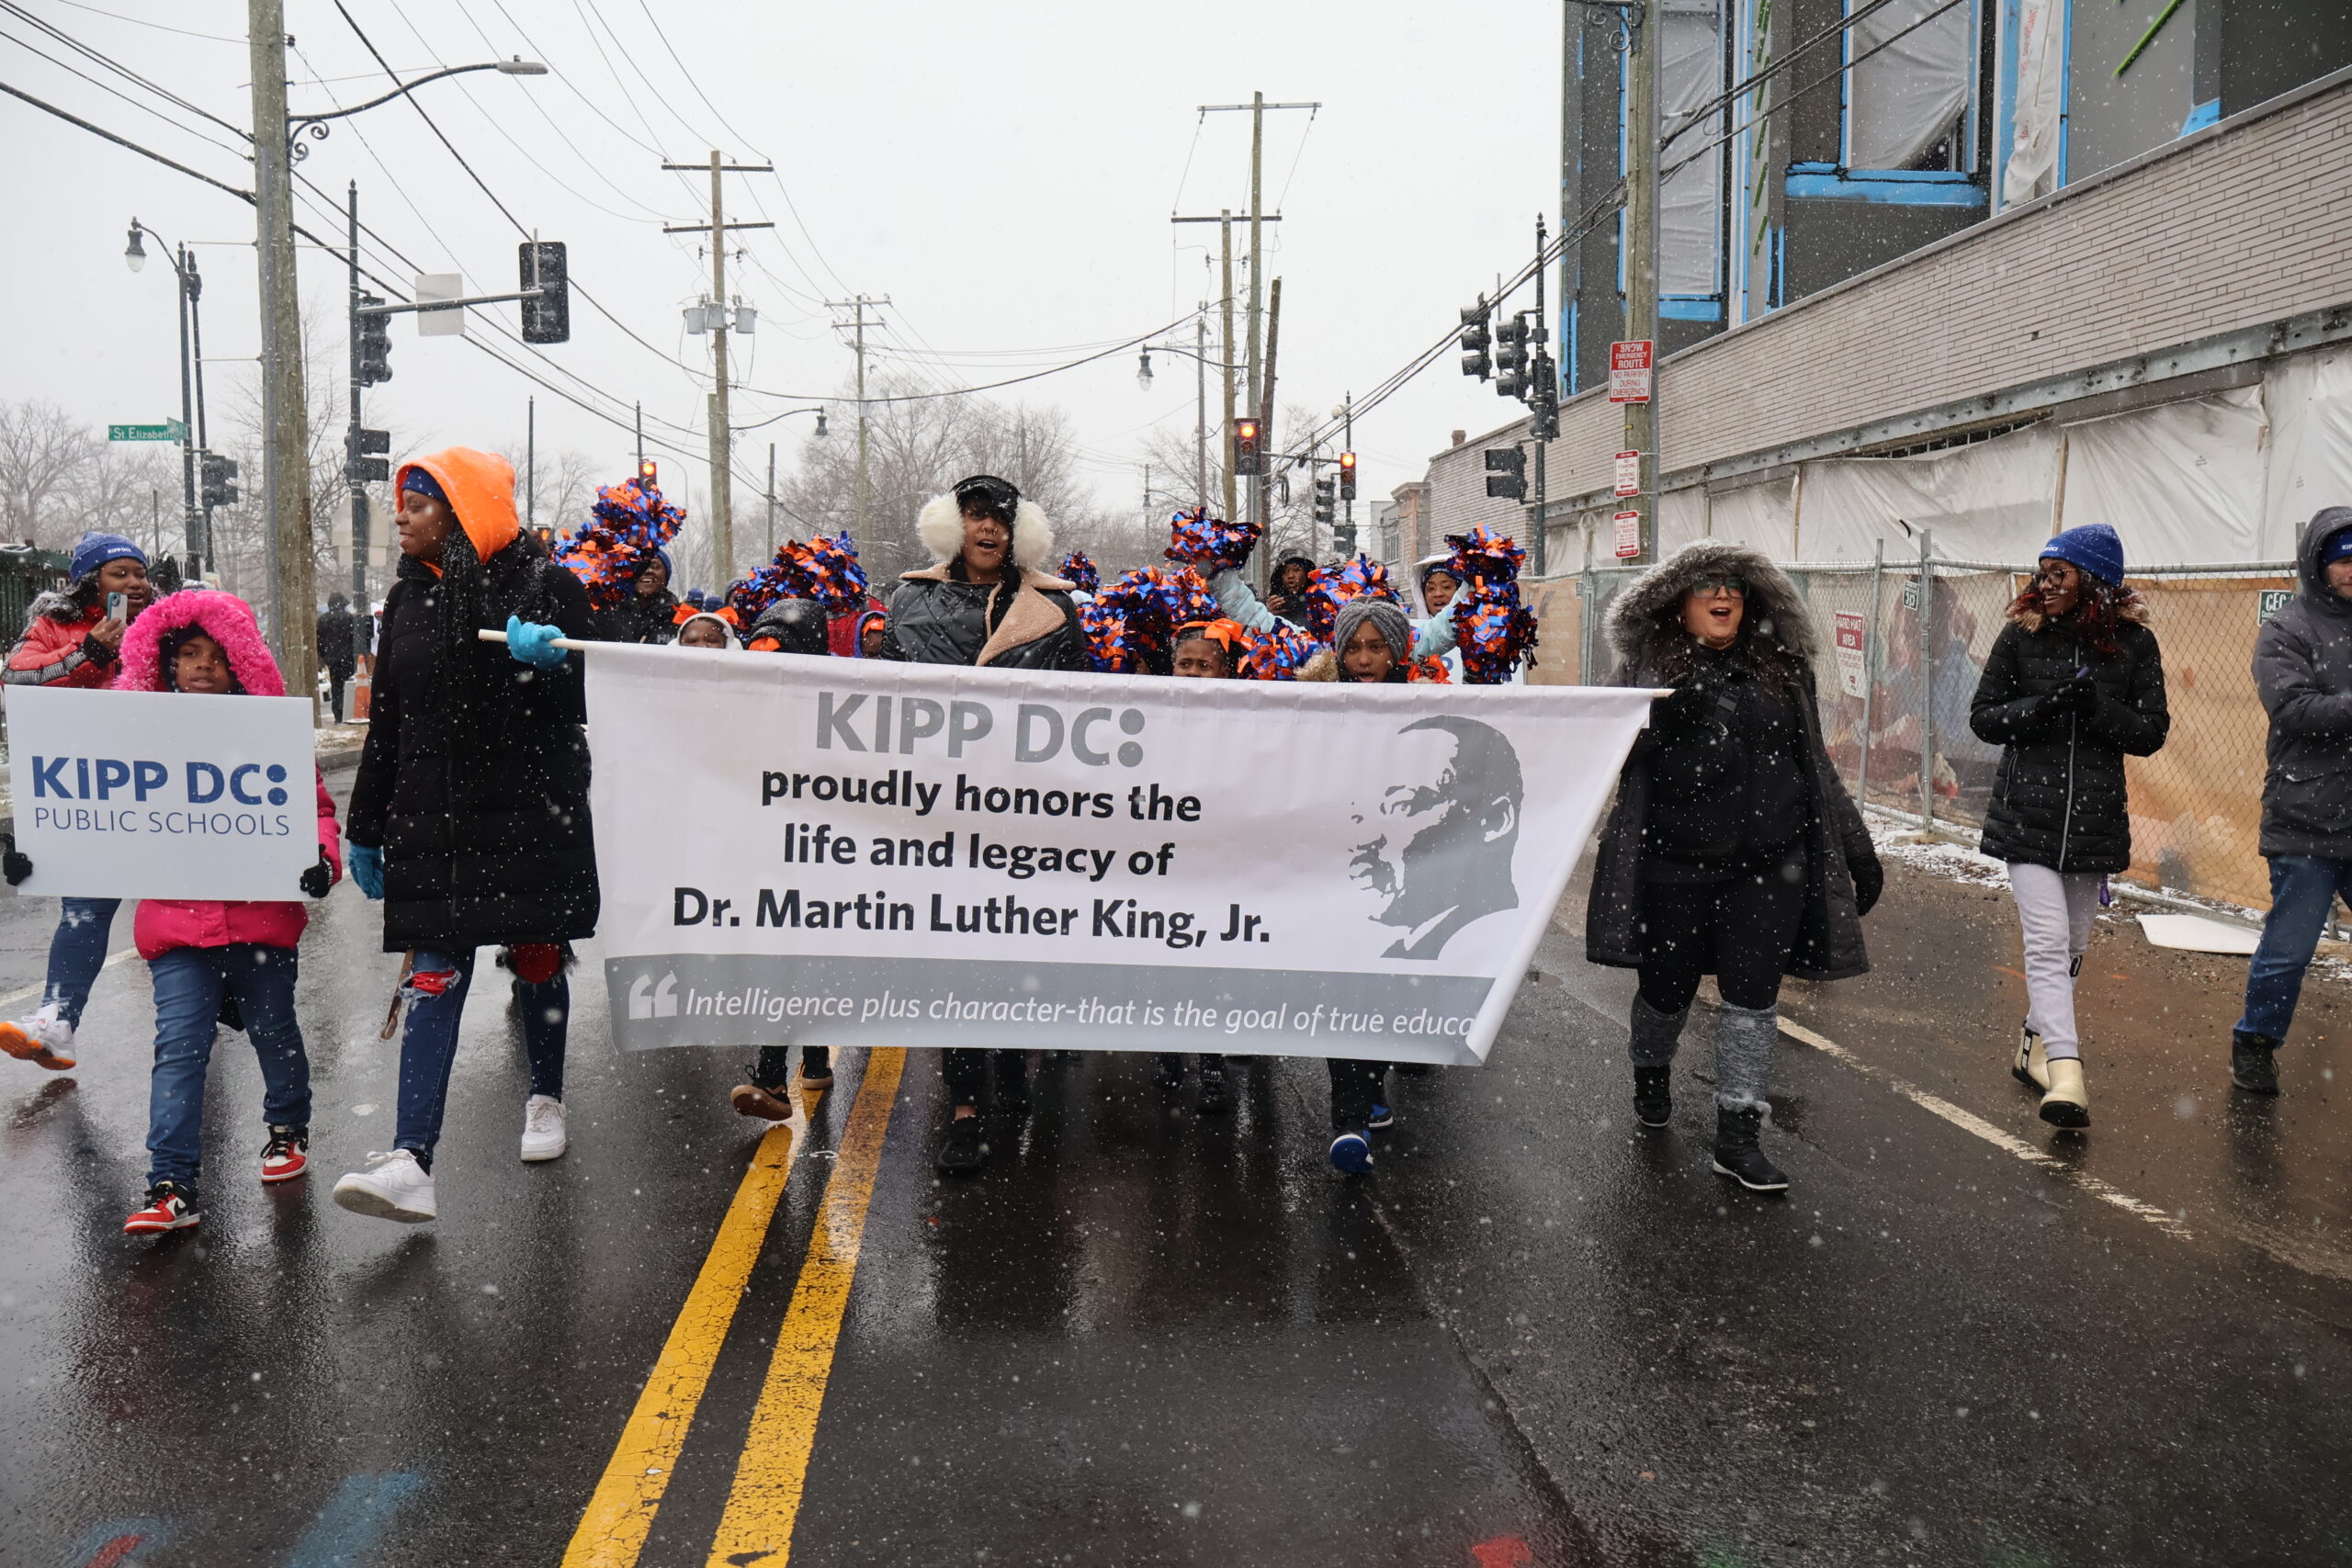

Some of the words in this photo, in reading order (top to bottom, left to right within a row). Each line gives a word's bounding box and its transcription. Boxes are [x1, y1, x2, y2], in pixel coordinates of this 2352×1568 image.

[1618, 359, 1644, 368] ROUTE
[1620, 343, 1645, 353] SNOW
[1612, 388, 1646, 396] EMERGENCY
[1842, 633, 1856, 648] AREA
[1850, 618, 1862, 632] HAT
[816, 691, 994, 759] KIPP
[1014, 704, 1146, 768] DC:
[31, 756, 168, 802] KIPP
[186, 761, 288, 807] DC:
[762, 768, 943, 817] proudly
[956, 773, 1114, 818] honors
[1127, 783, 1202, 822] the
[35, 807, 138, 832] PUBLIC
[149, 811, 290, 837] SCHOOLS
[784, 822, 857, 865] life
[869, 831, 955, 868] and
[968, 832, 1117, 883] legacy
[1128, 842, 1176, 876] of
[673, 886, 741, 928] Dr.
[755, 888, 915, 931] Martin
[930, 893, 1079, 936] Luther
[1091, 898, 1207, 950] King,
[1219, 903, 1271, 943] Jr.
[860, 990, 921, 1023] plus
[1142, 998, 1165, 1026] is
[1172, 998, 1217, 1029] the
[1224, 1001, 1287, 1034] goal
[1293, 1003, 1324, 1037] of
[1329, 1007, 1385, 1033] true
